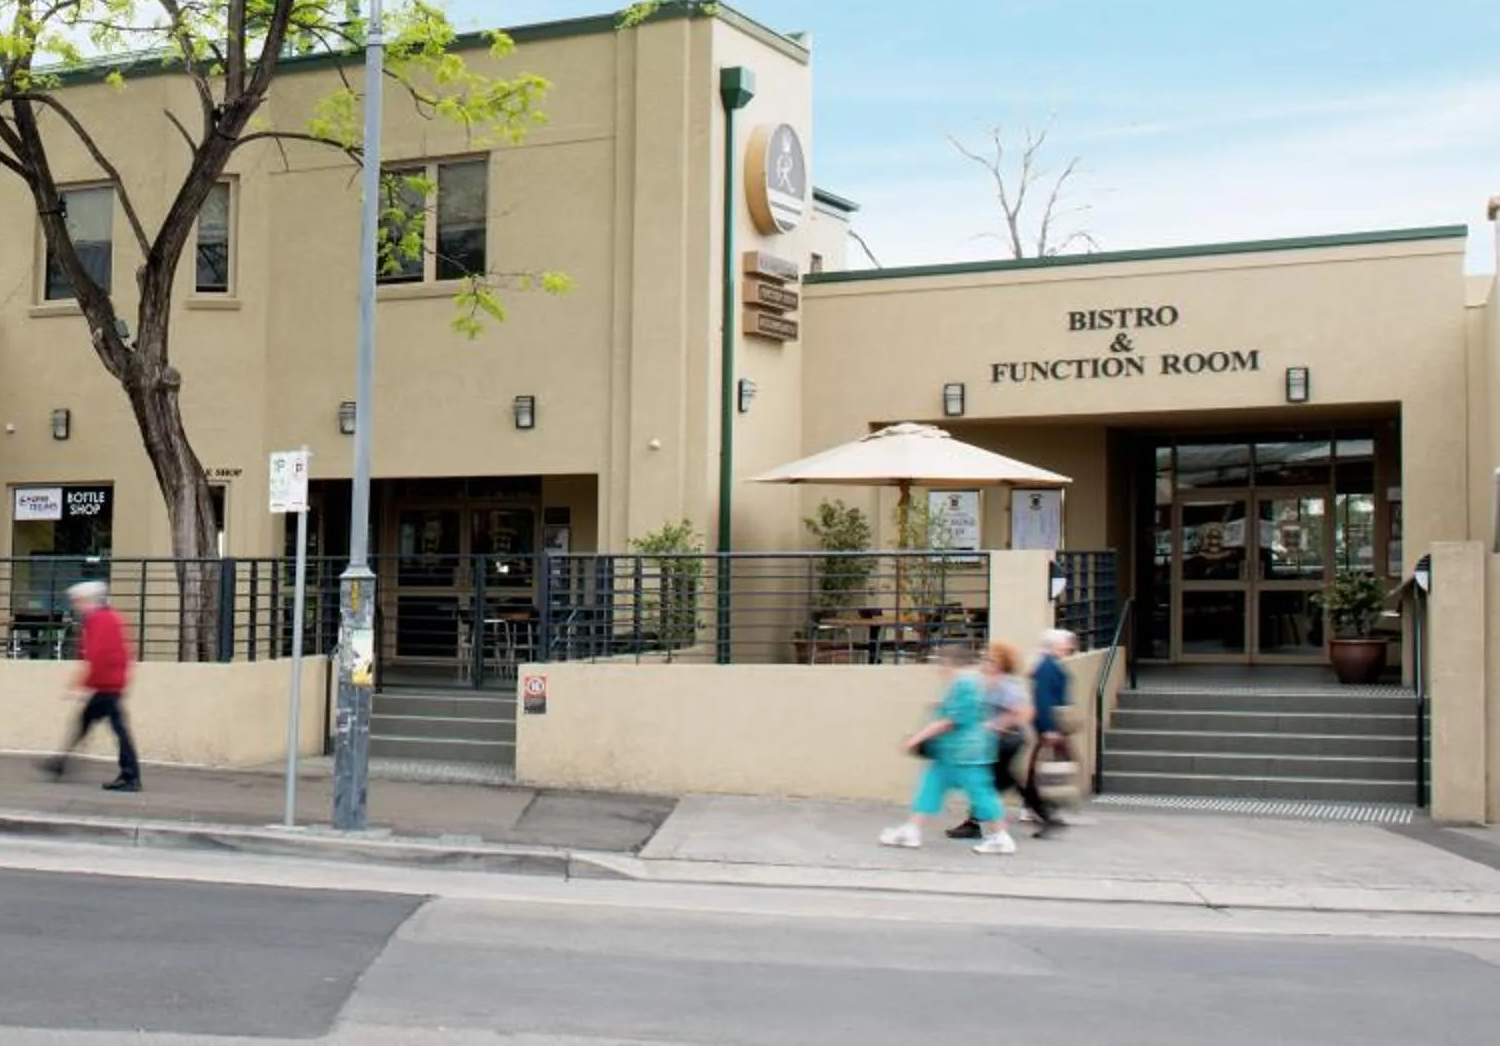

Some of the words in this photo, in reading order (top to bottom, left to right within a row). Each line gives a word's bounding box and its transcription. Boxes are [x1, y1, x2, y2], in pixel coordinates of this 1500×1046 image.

[1068, 305, 1179, 331] BISTRO
[1109, 332, 1133, 353] &
[990, 356, 1145, 383] FUNCTION
[1160, 350, 1260, 375] ROOM
[67, 491, 105, 503] BOTTLE
[69, 503, 100, 515] SHOP
